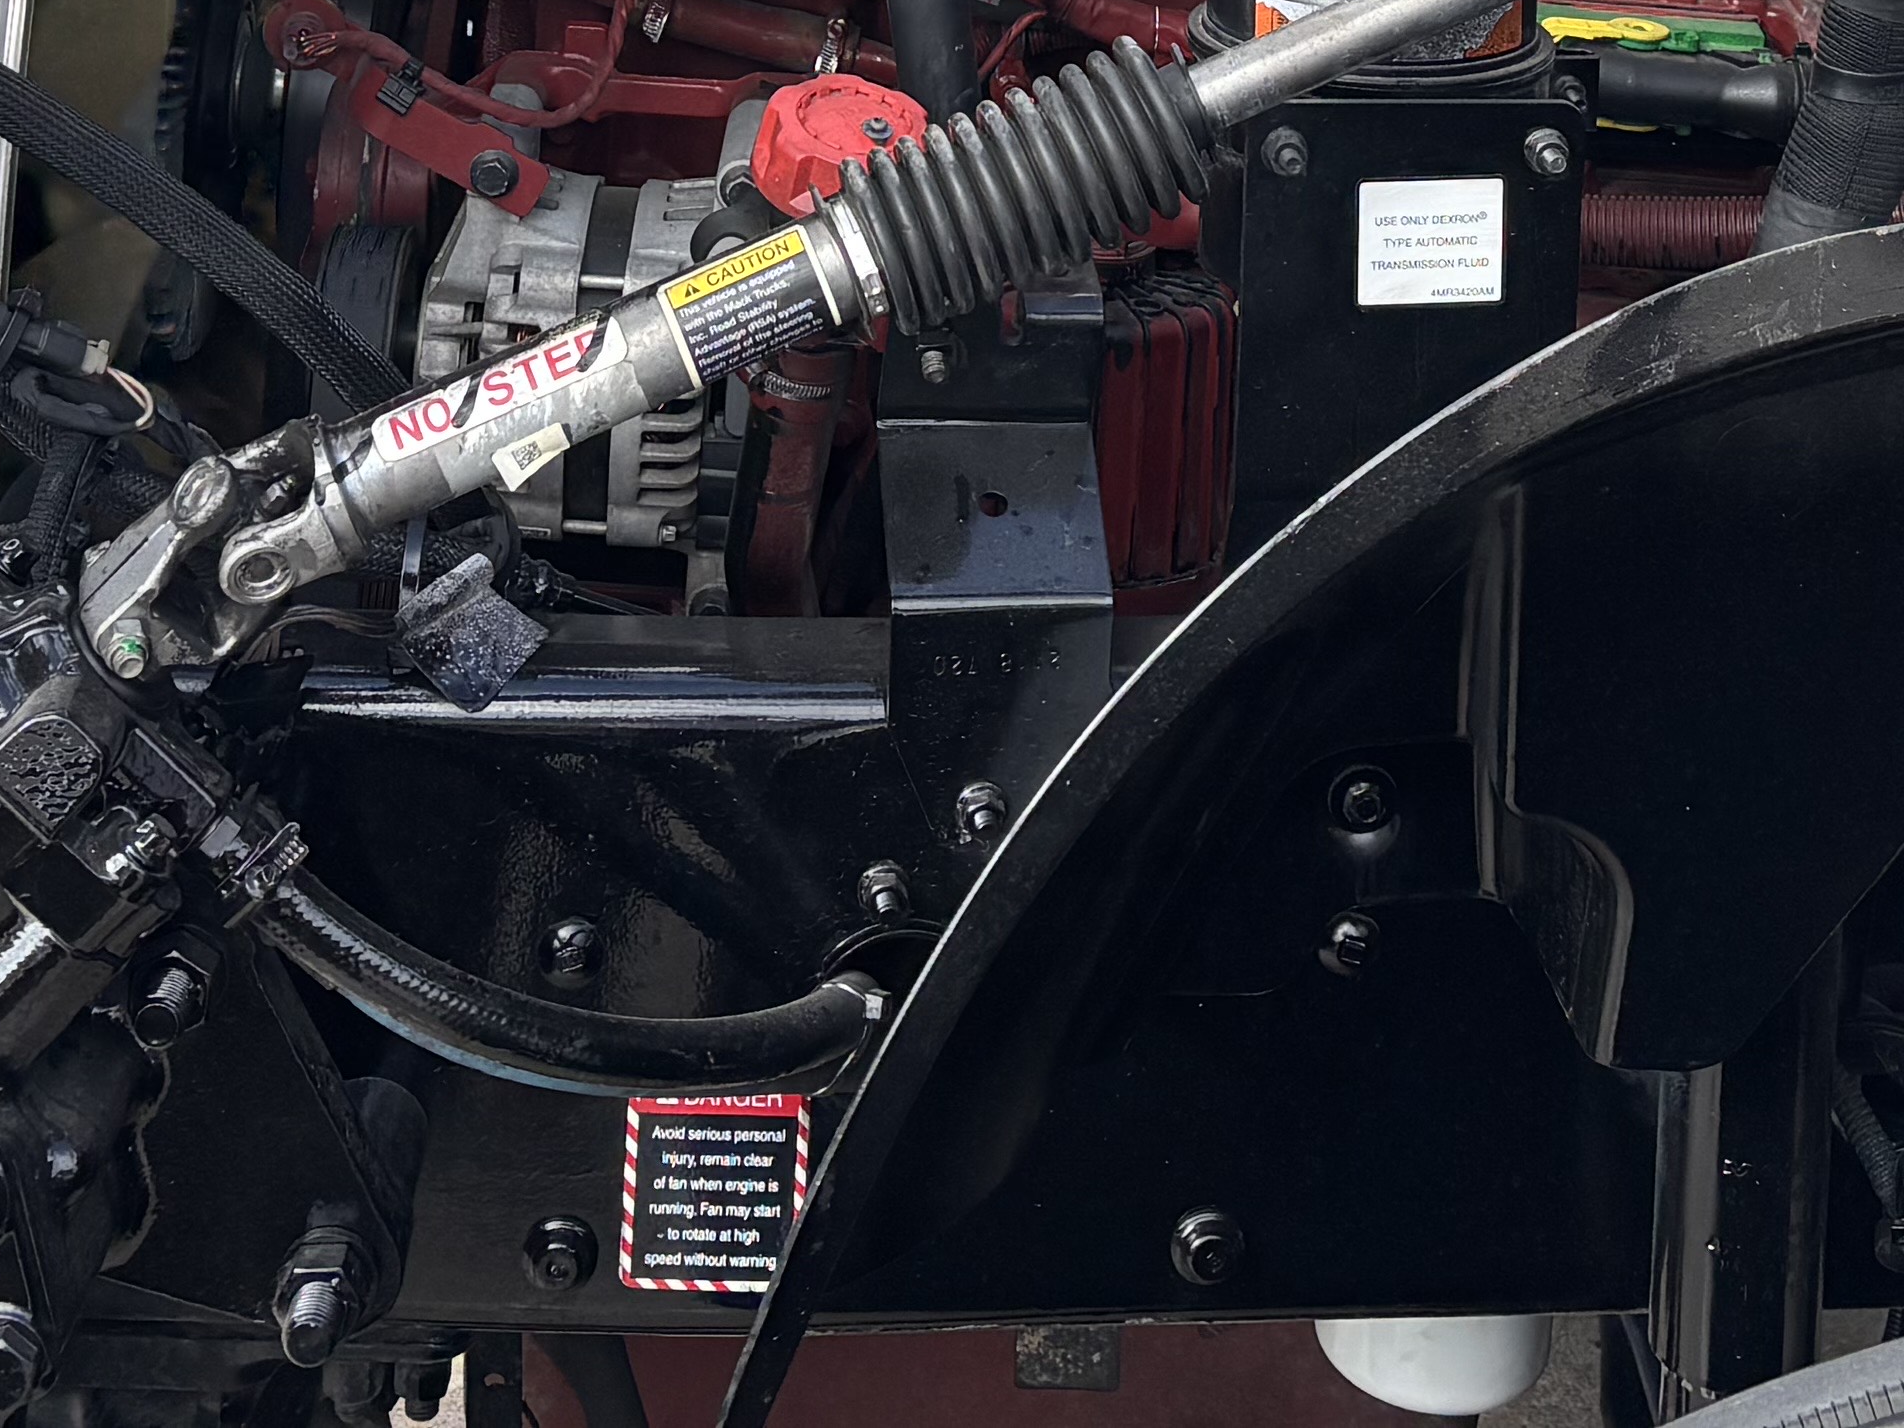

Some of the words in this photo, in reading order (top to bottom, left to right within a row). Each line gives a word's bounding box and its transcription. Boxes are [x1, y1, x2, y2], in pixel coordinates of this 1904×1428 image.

[1375, 216, 1397, 227] USE
[1401, 215, 1429, 225] ONLY
[1383, 238, 1412, 248] TYPE
[1416, 236, 1478, 247] AUTOMATIC
[706, 240, 790, 287] CAUTION
[1370, 259, 1454, 271] TRANSMISSION
[1458, 257, 1489, 267] FLUID
[679, 303, 700, 317] This
[702, 288, 736, 309] vehicle
[738, 284, 747, 293] is
[749, 260, 795, 288] equipped
[684, 317, 705, 332] with
[707, 307, 723, 322] the
[725, 294, 752, 315] Mack
[753, 280, 790, 299] Trucks,
[688, 332, 708, 345] Inc.
[709, 318, 737, 335] Road
[738, 299, 778, 321] Stability
[694, 329, 746, 357] Advantage
[748, 313, 776, 333] (RSA)
[777, 297, 816, 319] system.
[698, 342, 741, 367] Removal
[755, 328, 772, 341] the
[774, 311, 814, 334] steering
[388, 397, 451, 450] NO
[652, 1125, 686, 1140] Avoid
[688, 1127, 731, 1141] serious
[734, 1128, 786, 1143] personal
[662, 1151, 696, 1169] injury,
[700, 1153, 740, 1166] remain
[744, 1153, 774, 1167] clear
[654, 1176, 666, 1189] of
[669, 1177, 687, 1190] fan
[690, 1177, 722, 1191] when
[725, 1179, 765, 1194] engine
[768, 1179, 779, 1193] is
[649, 1203, 697, 1219] running.
[700, 1202, 723, 1217] Fan
[725, 1205, 751, 1220] may
[753, 1204, 781, 1218] start
[667, 1228, 679, 1241] to
[682, 1228, 716, 1241] rotate
[719, 1229, 731, 1241] at
[734, 1228, 760, 1245] high
[645, 1252, 681, 1268] speed
[684, 1252, 727, 1267] without
[729, 1254, 777, 1271] warning
